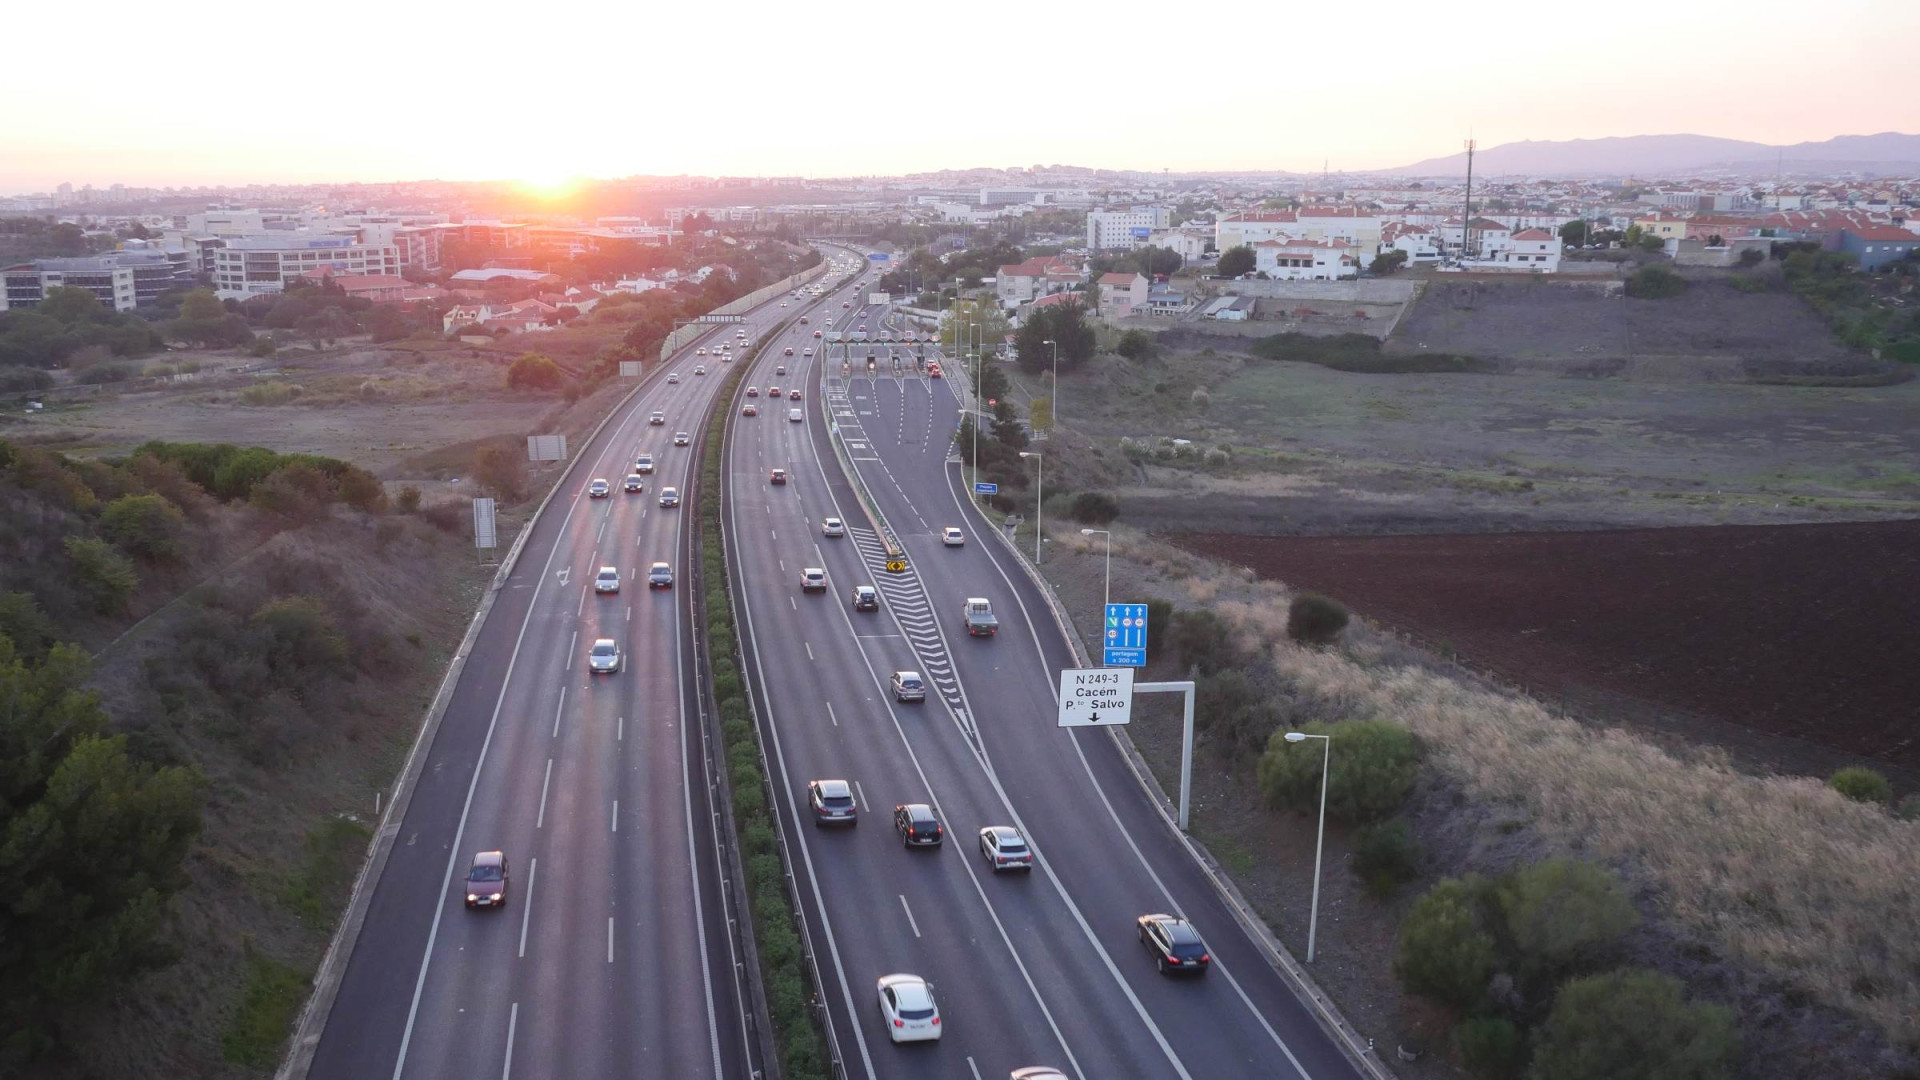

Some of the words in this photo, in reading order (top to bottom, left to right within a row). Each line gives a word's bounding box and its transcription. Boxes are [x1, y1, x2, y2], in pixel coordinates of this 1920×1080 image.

[1076, 675, 1085, 684] N
[1088, 674, 1119, 684] 249-3
[1075, 687, 1117, 697] Cacém
[1090, 699, 1125, 709] Salvo
